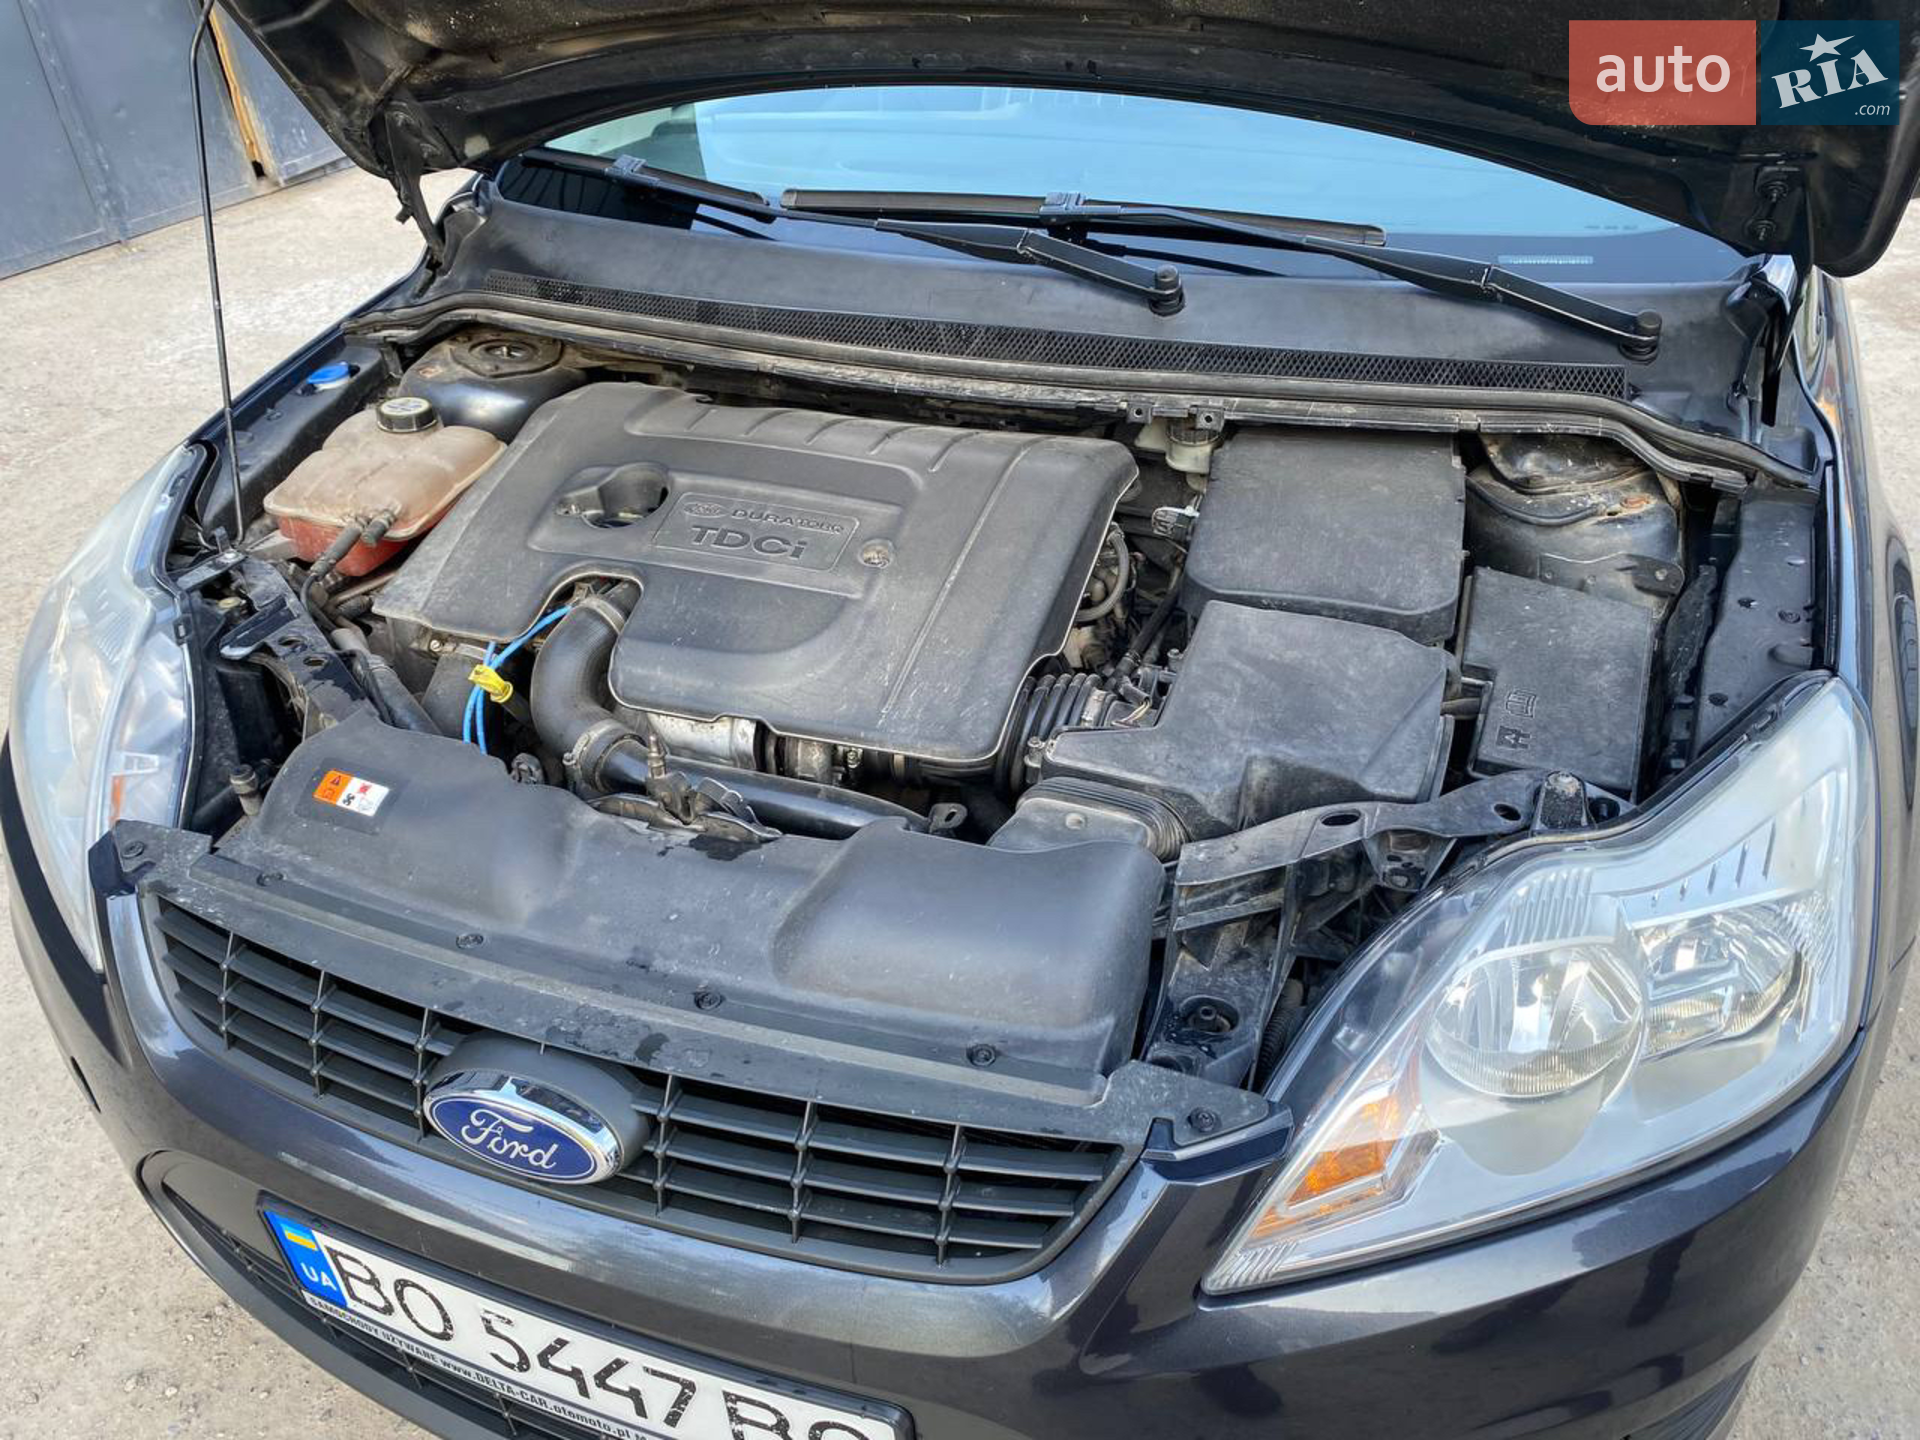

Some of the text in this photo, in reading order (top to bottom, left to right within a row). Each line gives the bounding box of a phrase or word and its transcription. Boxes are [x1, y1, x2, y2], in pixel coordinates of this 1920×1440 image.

[691, 524, 808, 560] TDCi
[461, 1108, 557, 1169] Ford
[300, 1262, 337, 1290] UA
[324, 1245, 455, 1342] BO
[480, 1308, 697, 1429] 5447
